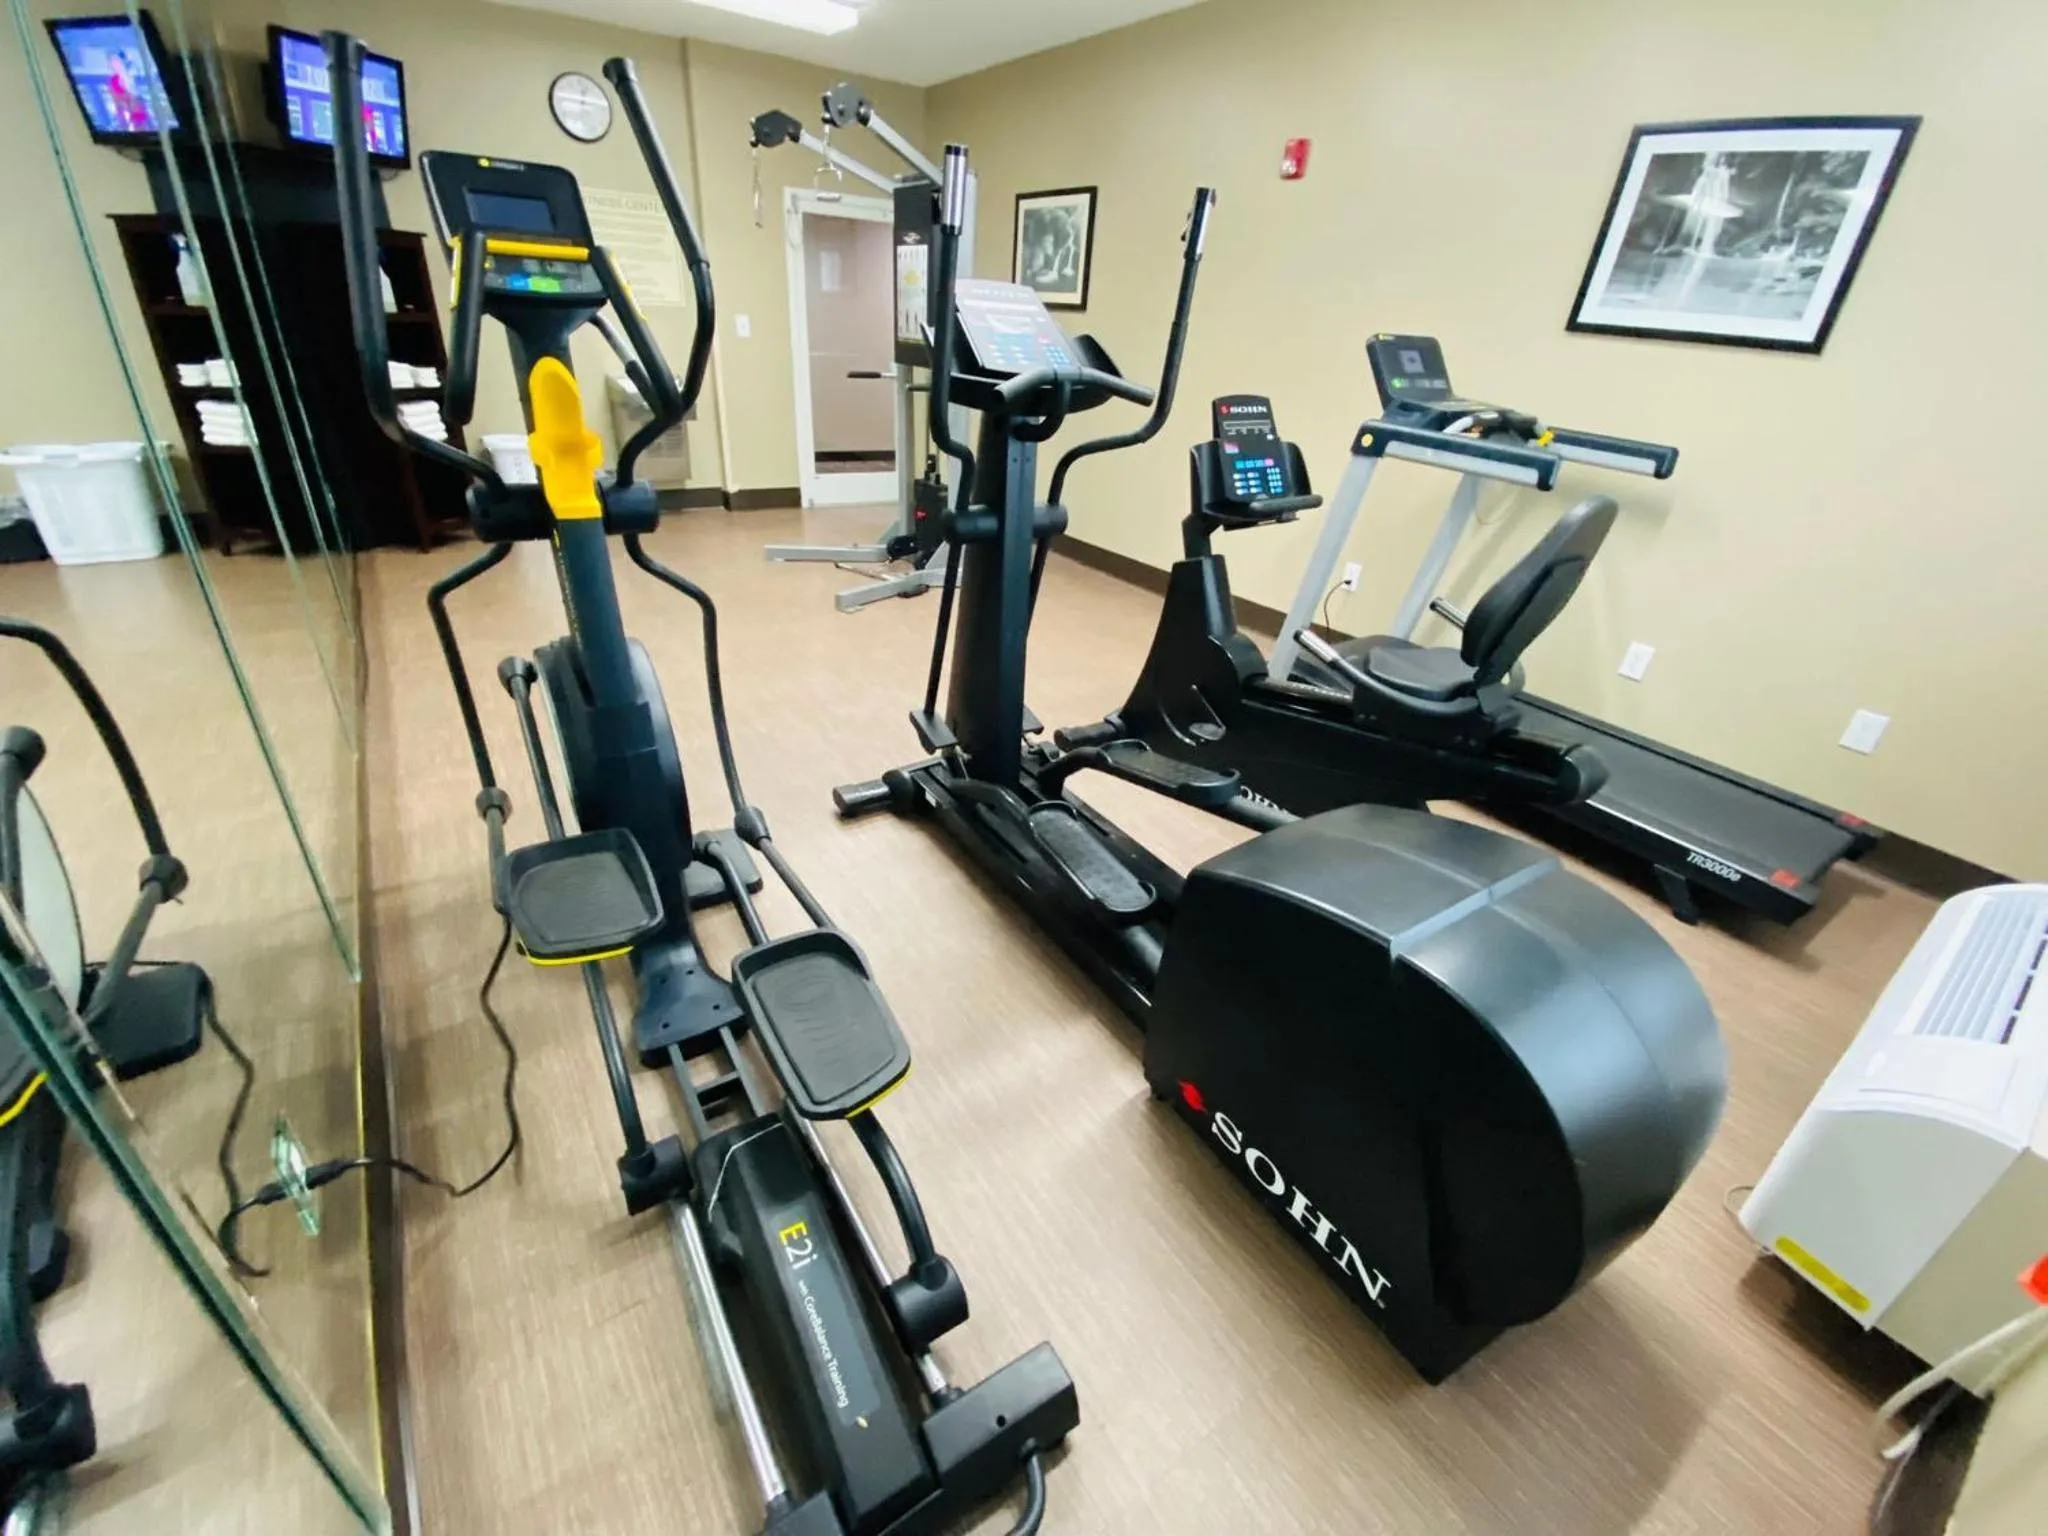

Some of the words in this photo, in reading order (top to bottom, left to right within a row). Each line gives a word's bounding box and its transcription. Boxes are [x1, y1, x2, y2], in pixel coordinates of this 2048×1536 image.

[1230, 405, 1267, 414] SOHN
[1211, 1111, 1391, 1302] SOHN
[778, 1220, 818, 1271] E2i
[827, 1357, 849, 1408] Training
